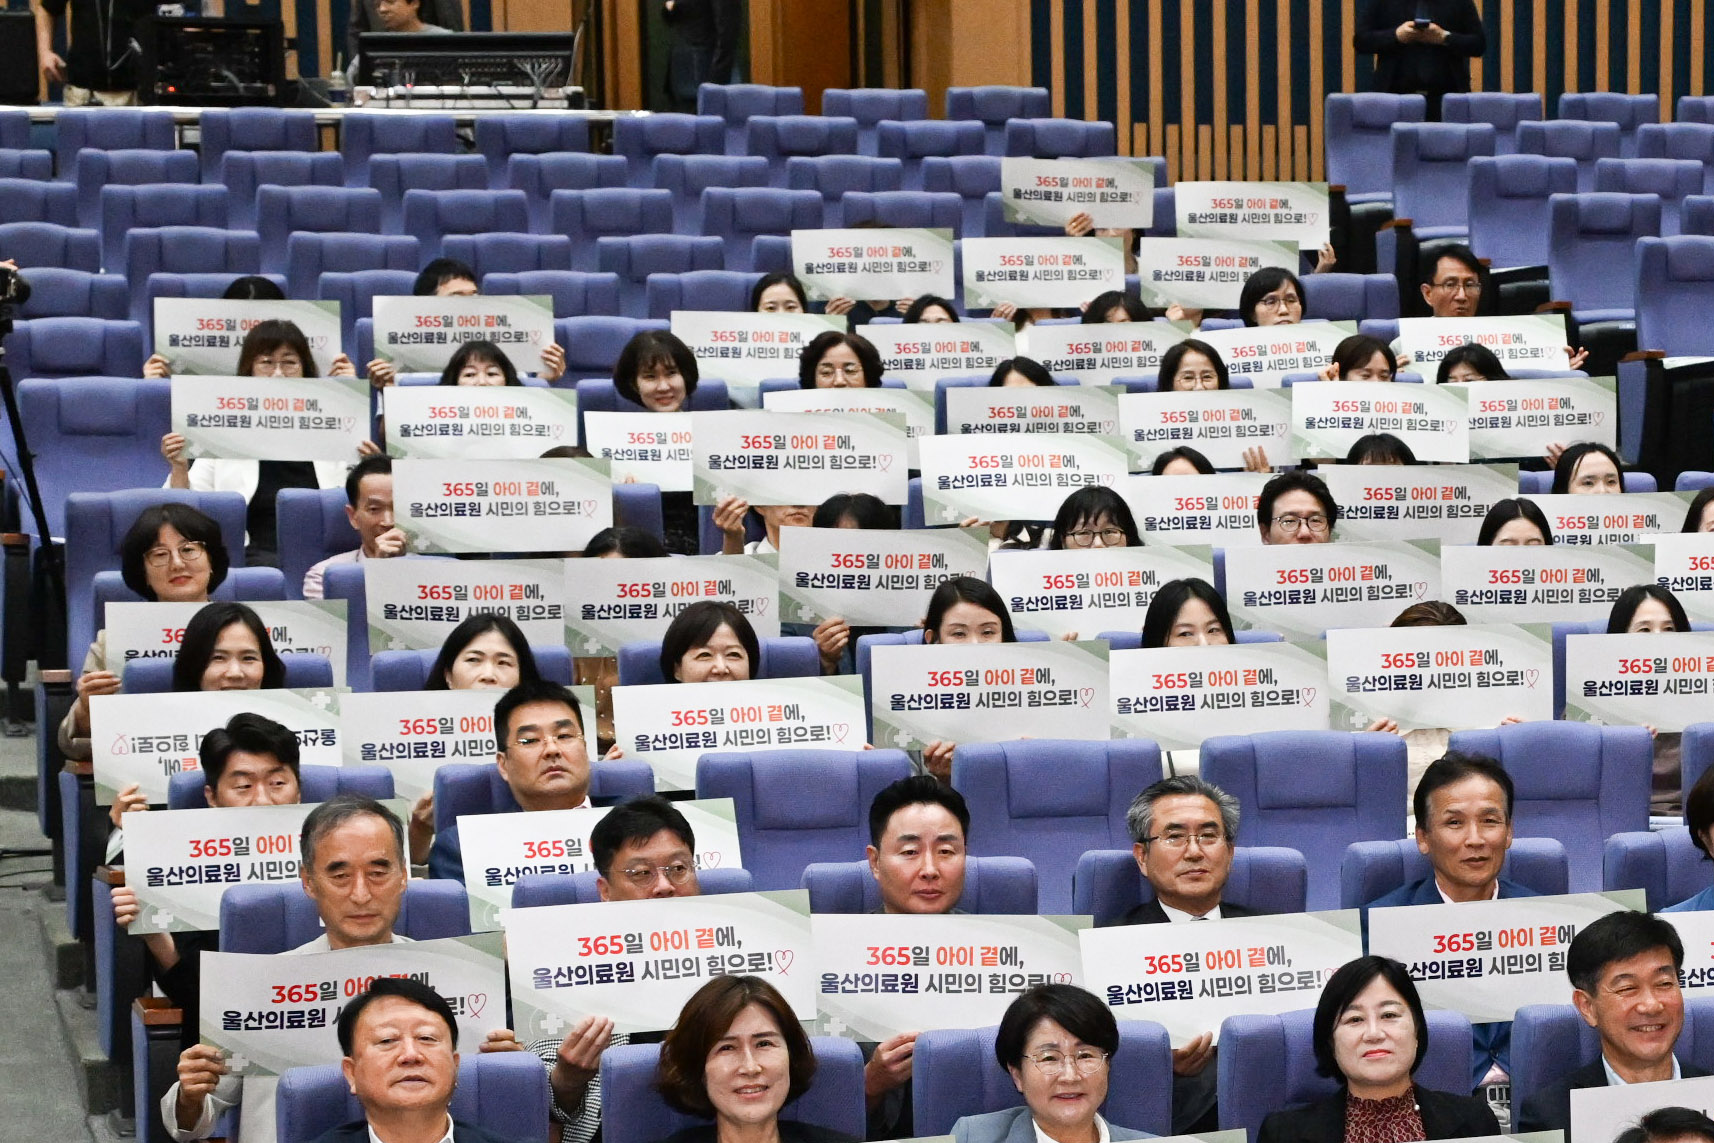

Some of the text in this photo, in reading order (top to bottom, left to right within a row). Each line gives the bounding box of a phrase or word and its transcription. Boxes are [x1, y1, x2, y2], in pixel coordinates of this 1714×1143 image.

[741, 435, 786, 450] 365일
[790, 435, 818, 450] 아이
[783, 455, 825, 470] 시민의
[829, 455, 876, 470] 힘으로!
[443, 482, 488, 497] 365일
[493, 481, 522, 496] 아이
[486, 501, 528, 517] 시민의
[532, 501, 581, 516] 힘으로!
[1276, 564, 1392, 584] 365일 아이 곁에,
[1243, 584, 1413, 607] 울산의료원 시민의 힘으로!
[1381, 649, 1503, 669] 365일 아이 곁에,
[928, 667, 1055, 687] 365일 아이 곁에,
[1346, 670, 1524, 692] 울산의료원 시민의 힘으로!
[890, 689, 1078, 711] 울산의료원 시민의 힘으로!
[671, 704, 805, 727] 365일 아이 곁에,
[634, 725, 831, 752] 울산의료원 시민의 힘으로!
[577, 926, 742, 957] 365일 아이 곁에,
[533, 952, 773, 989] 울산의료원 시민의 힘으로!
[1144, 945, 1293, 975] 365일 아이 곁에,
[1106, 970, 1322, 1006] 울산의료원 시민의 힘으로!
